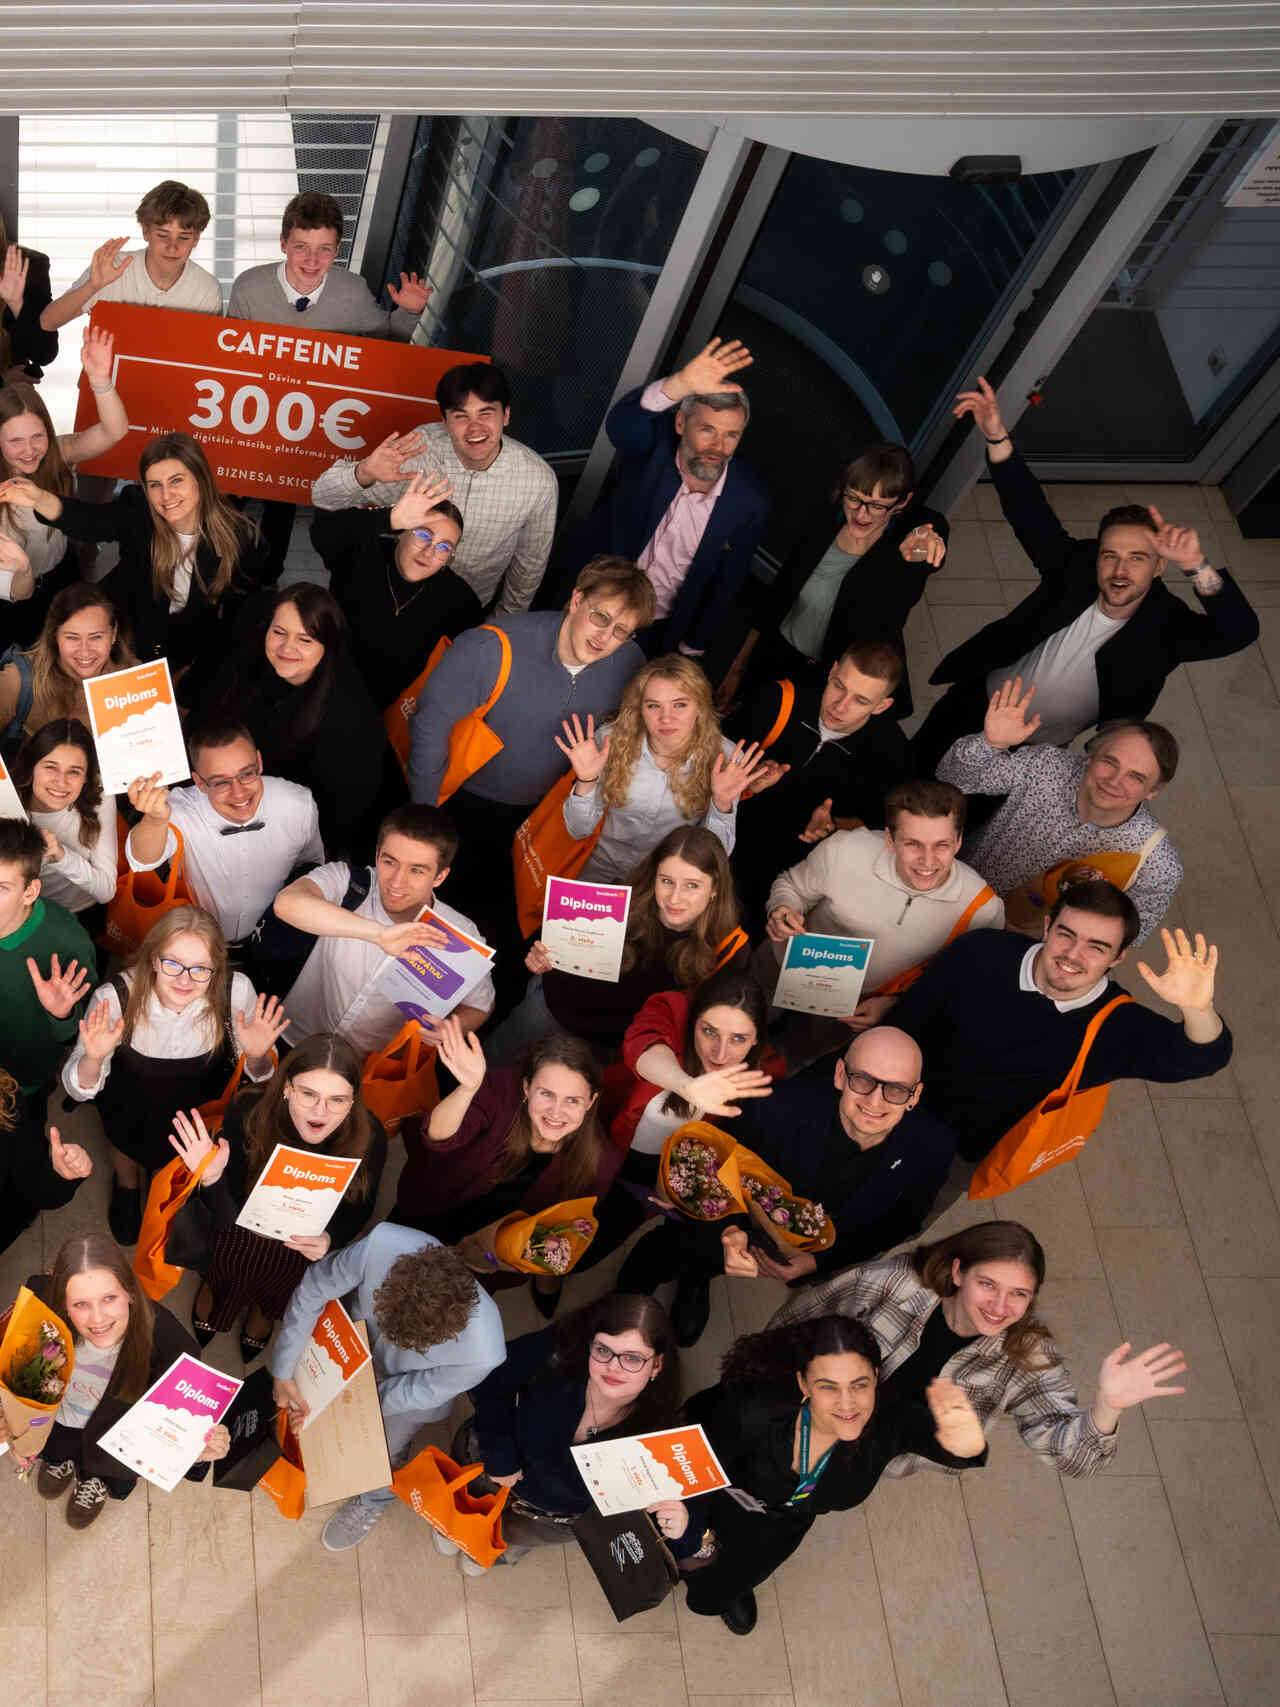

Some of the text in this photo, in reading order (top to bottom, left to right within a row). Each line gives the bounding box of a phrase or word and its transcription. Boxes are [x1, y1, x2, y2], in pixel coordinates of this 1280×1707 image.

[217, 328, 362, 370] CAFFEINE
[188, 379, 371, 450] 300€
[216, 466, 273, 483] BIZNESA
[104, 687, 159, 710] Diploms
[560, 896, 613, 913] Diploms
[801, 947, 854, 962] Diploms
[283, 1165, 336, 1184] Diploms
[322, 1317, 351, 1364] Diploms
[174, 1379, 220, 1410] Diploms
[671, 1442, 699, 1486] Diploms
